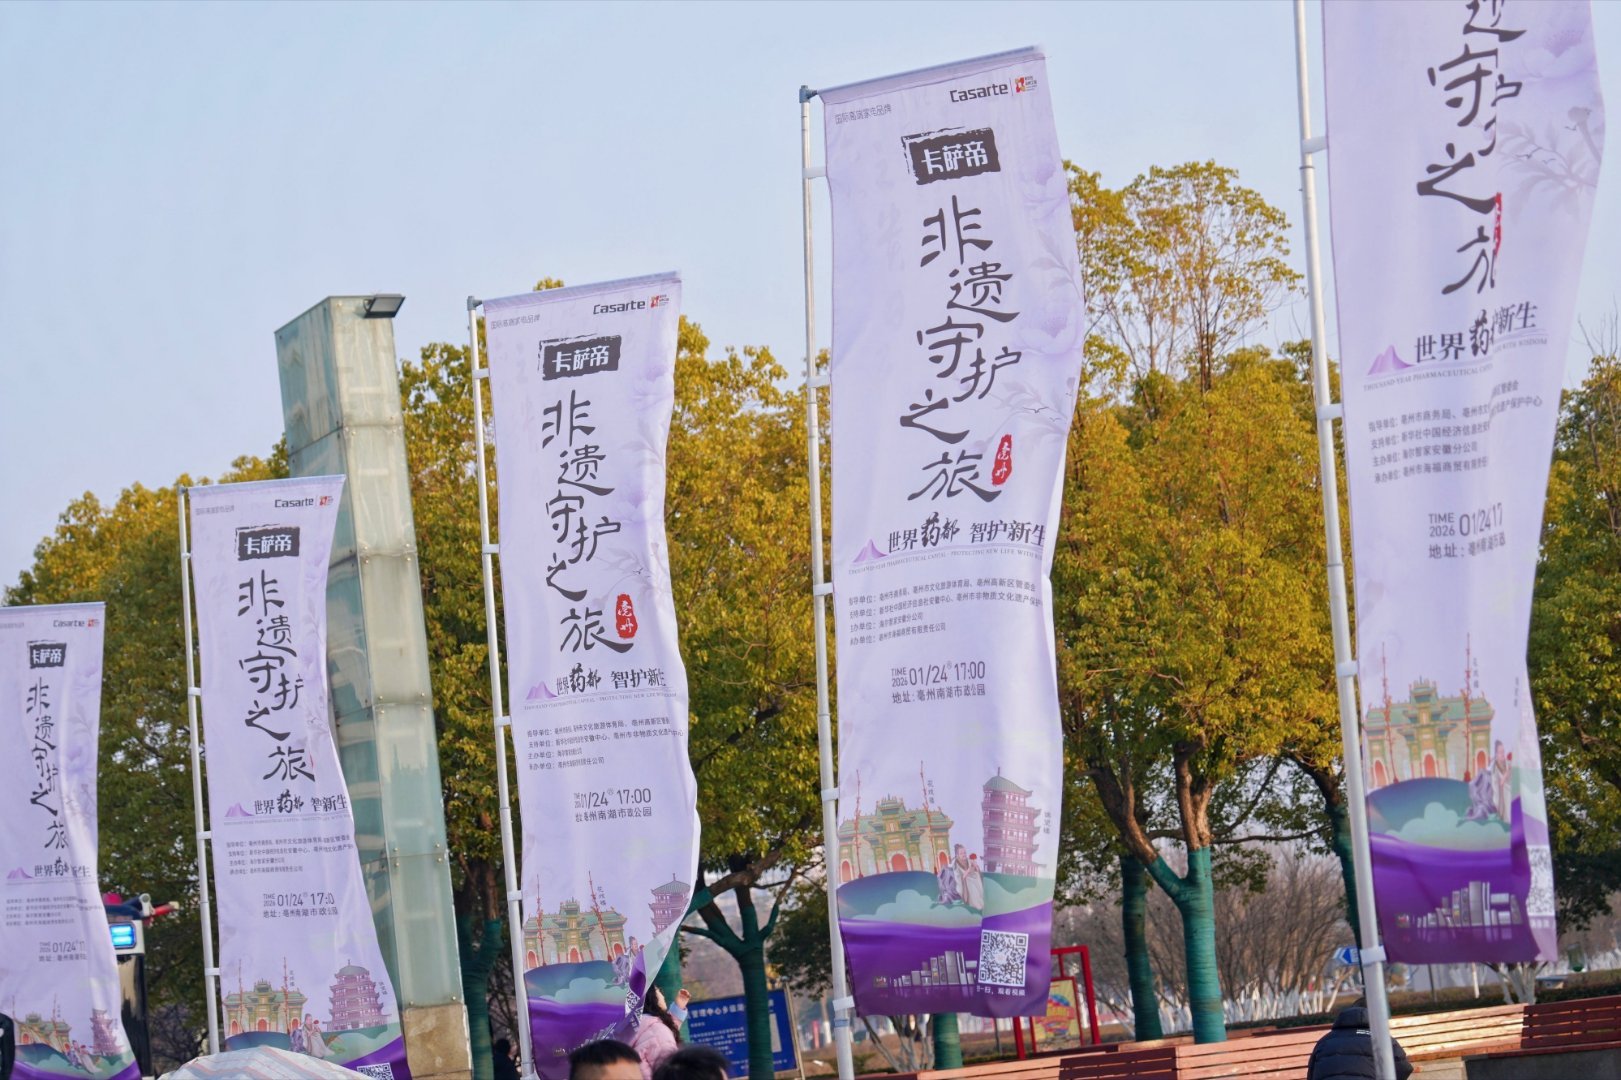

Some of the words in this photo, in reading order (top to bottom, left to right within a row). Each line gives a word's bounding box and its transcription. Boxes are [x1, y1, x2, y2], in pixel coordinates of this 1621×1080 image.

[950, 84, 1009, 103] Casarte
[921, 141, 988, 174] 卡萨帝
[593, 299, 646, 315] Casarte
[900, 195, 1021, 502] 非遗守护之旅
[551, 345, 610, 373] 卡萨帝
[274, 497, 314, 508] Casarte
[542, 389, 634, 653] 非遗守护之旅
[1428, 513, 1454, 524] TIME
[888, 512, 960, 553] 世界药都
[970, 519, 1046, 548] 智护新生
[1429, 526, 1455, 537] 2026
[244, 534, 292, 555] 卡萨帝
[53, 619, 85, 628] Casarte
[32, 648, 62, 664] 卡萨帝
[892, 667, 907, 677] TIME
[909, 664, 948, 686] 01/24
[954, 661, 986, 681] 17:00
[892, 677, 908, 687] 2026
[617, 788, 652, 804] 17:00
[277, 894, 304, 907] 01/24
[52, 942, 76, 953] 01/24
